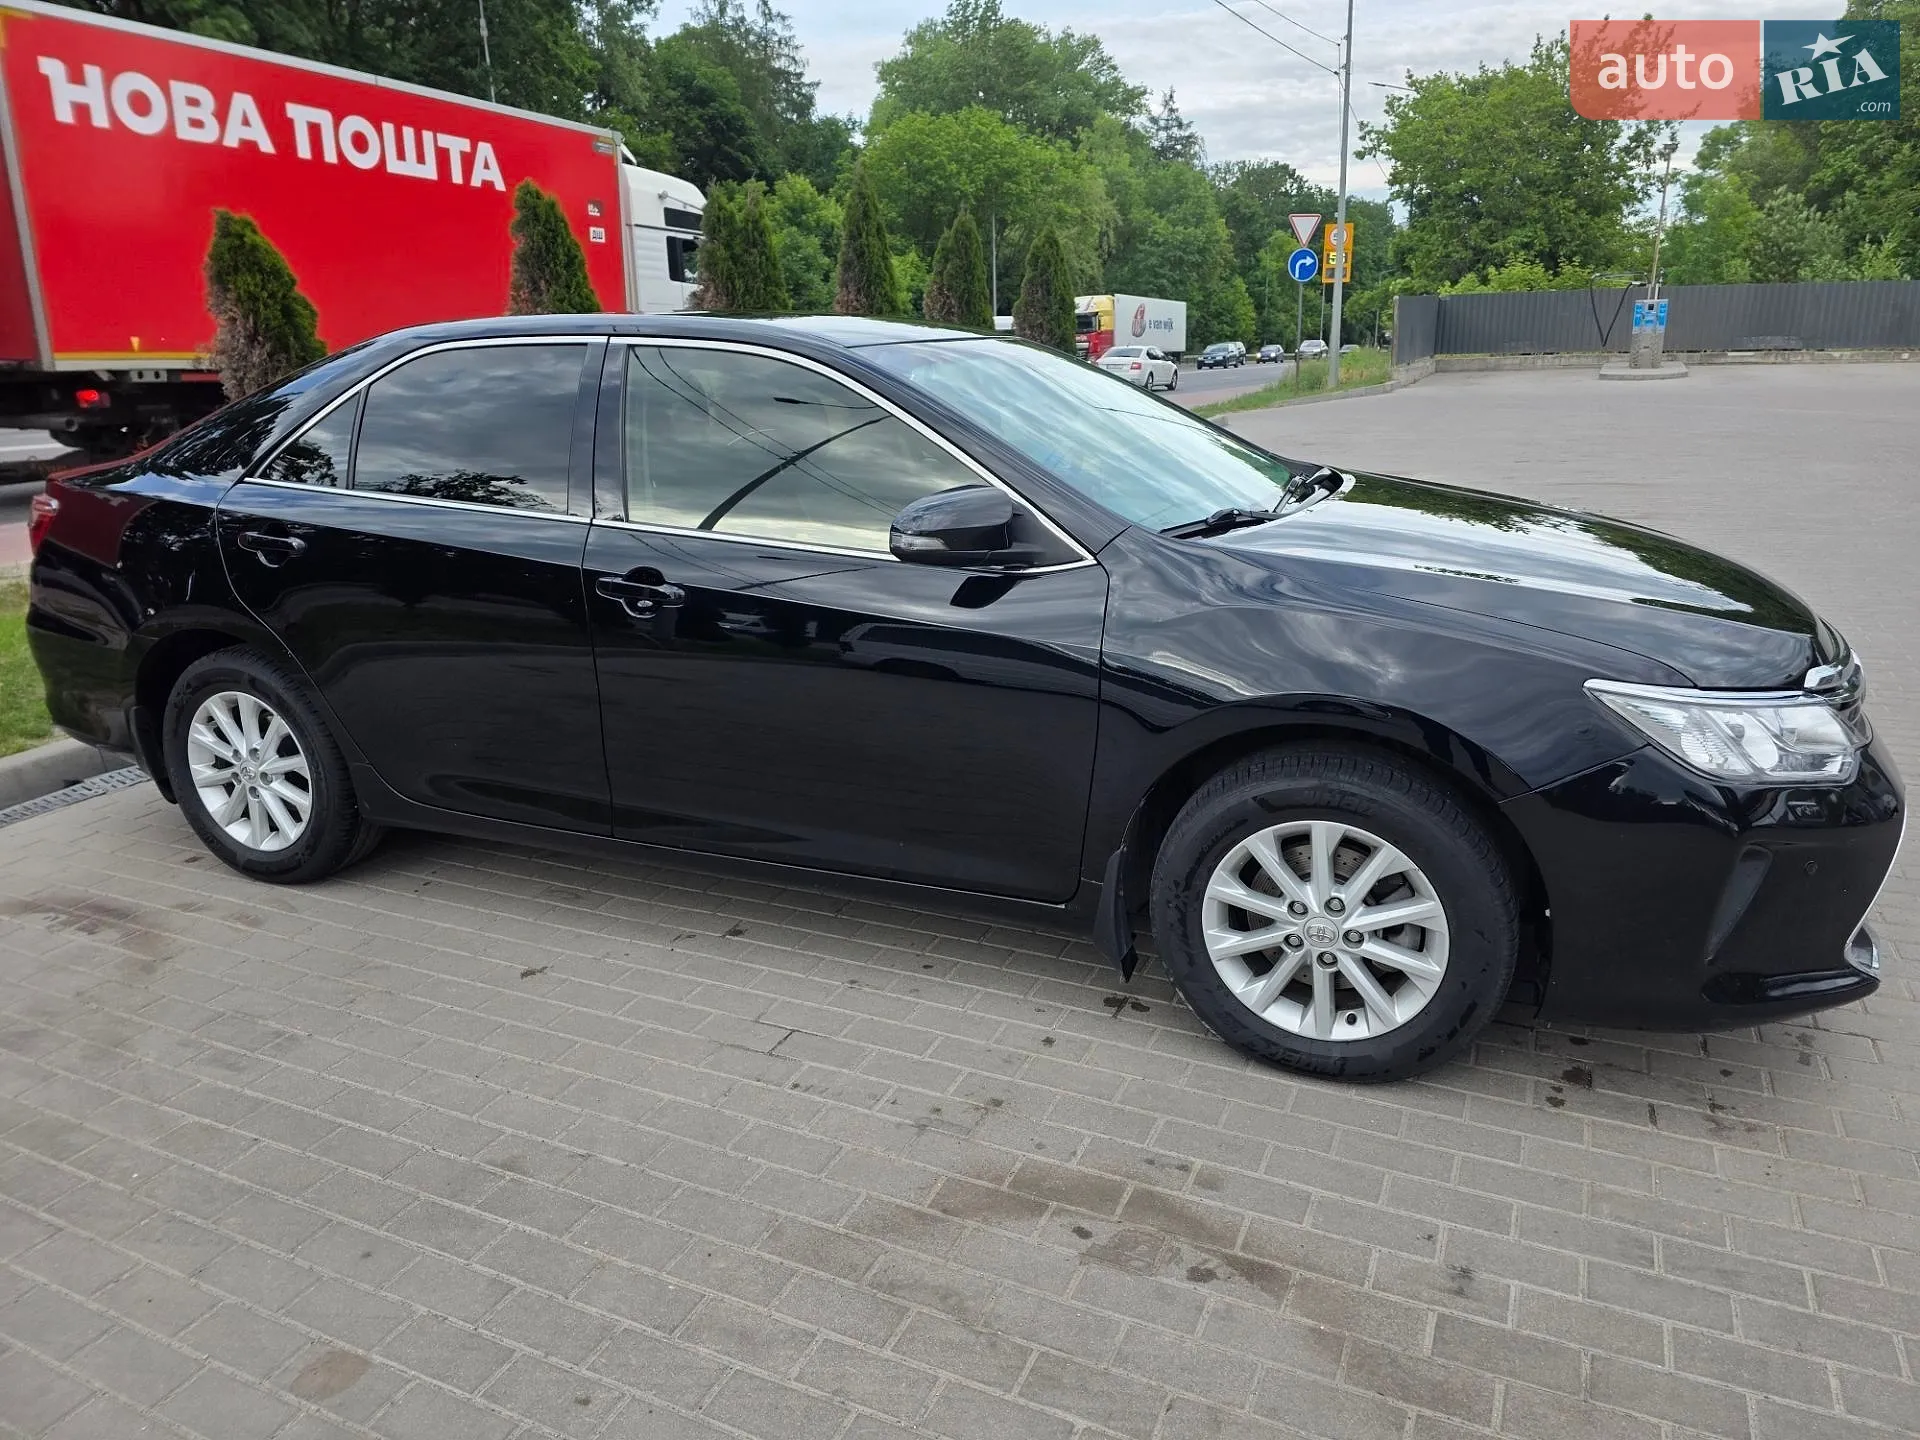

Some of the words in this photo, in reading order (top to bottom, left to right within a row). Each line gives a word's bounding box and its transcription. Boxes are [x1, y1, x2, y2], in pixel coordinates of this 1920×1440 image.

[36, 55, 277, 155] НОВА
[285, 102, 507, 192] ПОШТА
[1153, 319, 1163, 330] van
